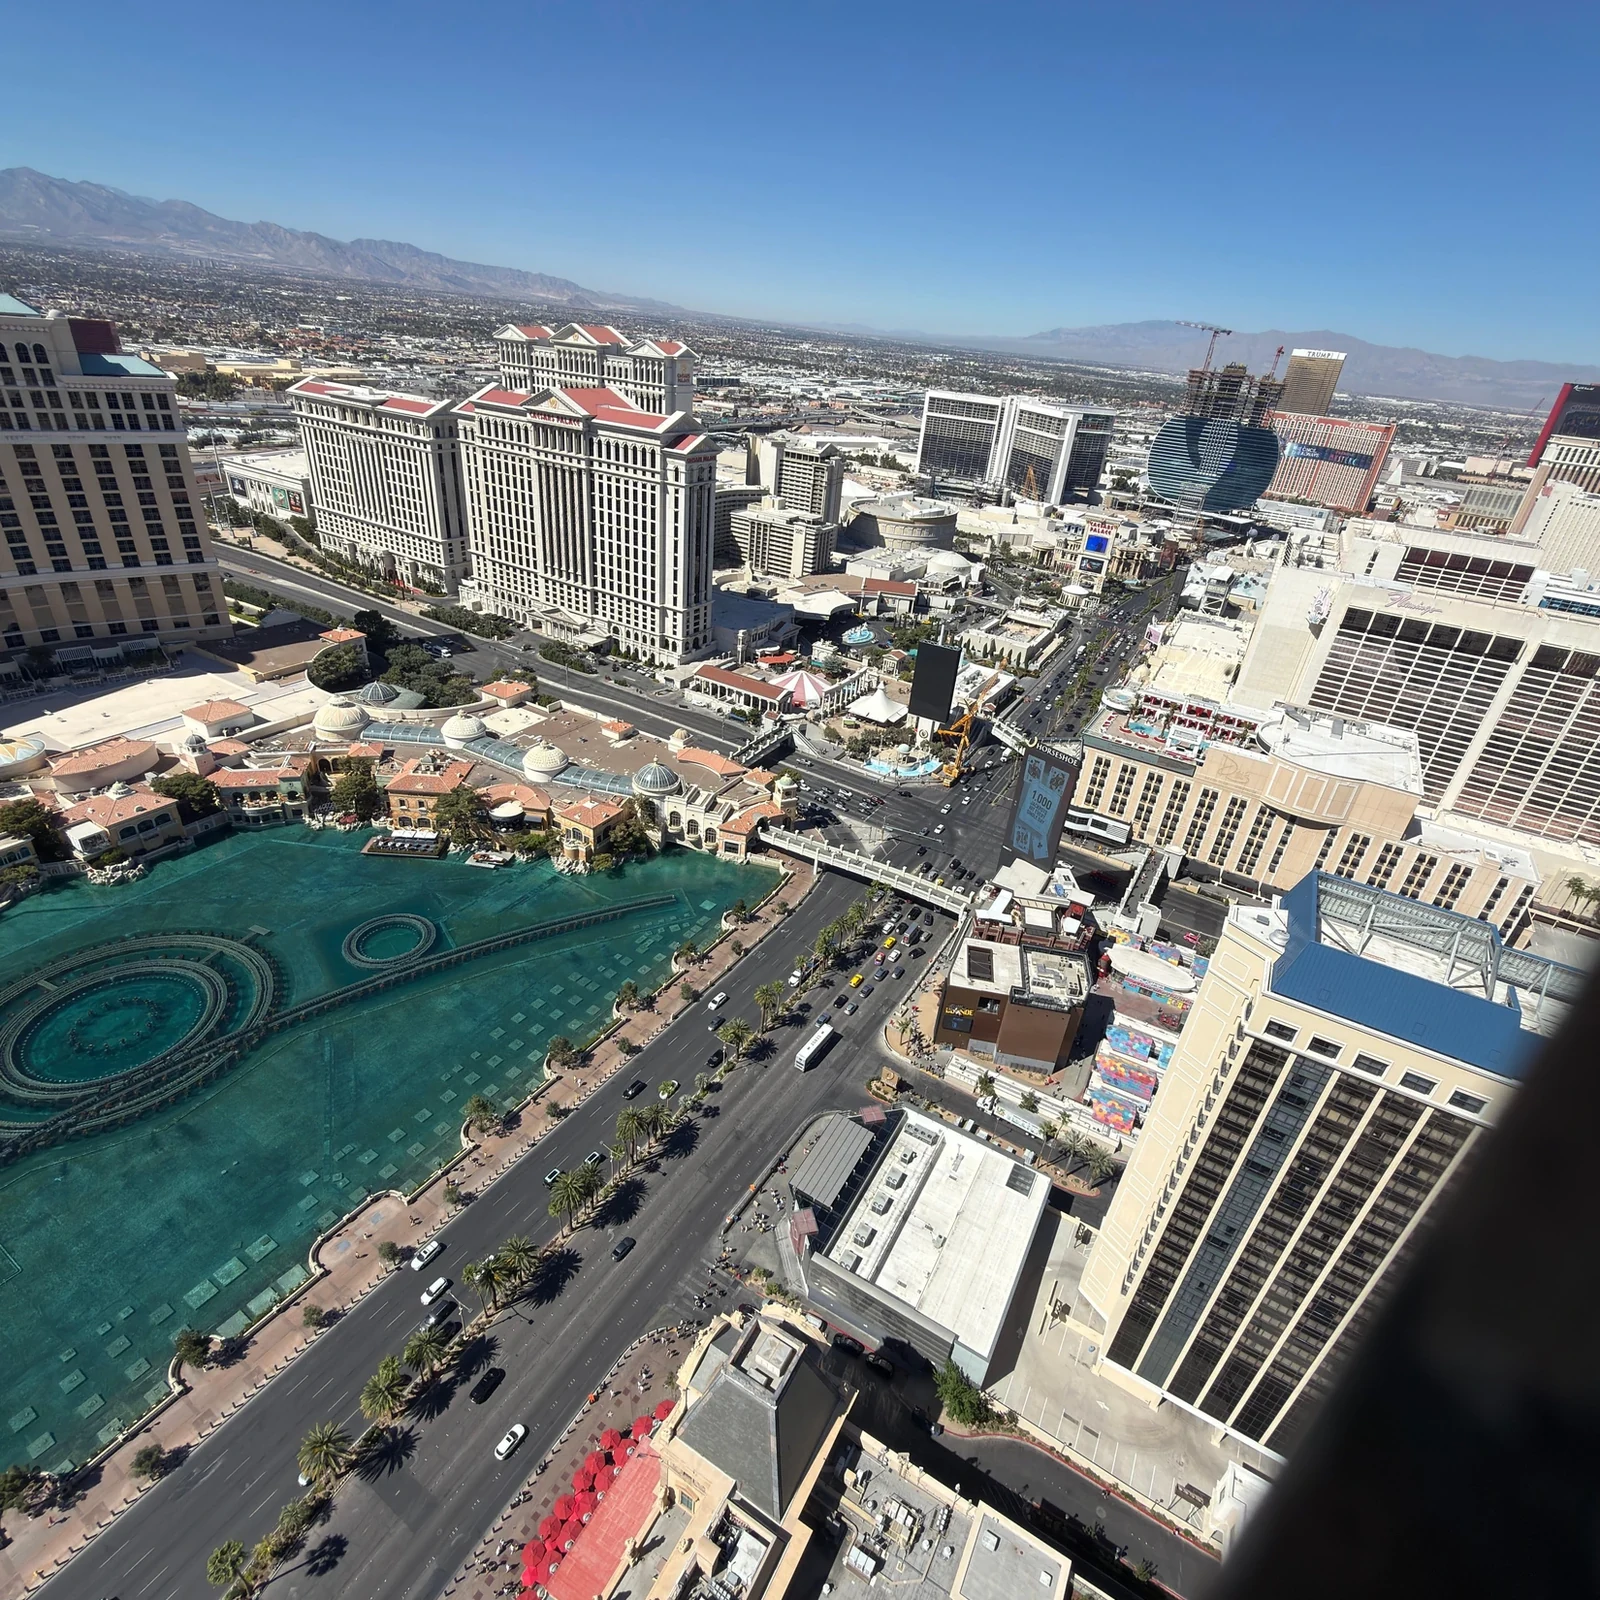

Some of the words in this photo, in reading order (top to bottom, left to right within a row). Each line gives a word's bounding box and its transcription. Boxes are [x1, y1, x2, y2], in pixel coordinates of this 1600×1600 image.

[557, 415, 580, 427] PALACE
[1385, 592, 1443, 616] Flamingo
[1036, 743, 1079, 767] HORSESHOE
